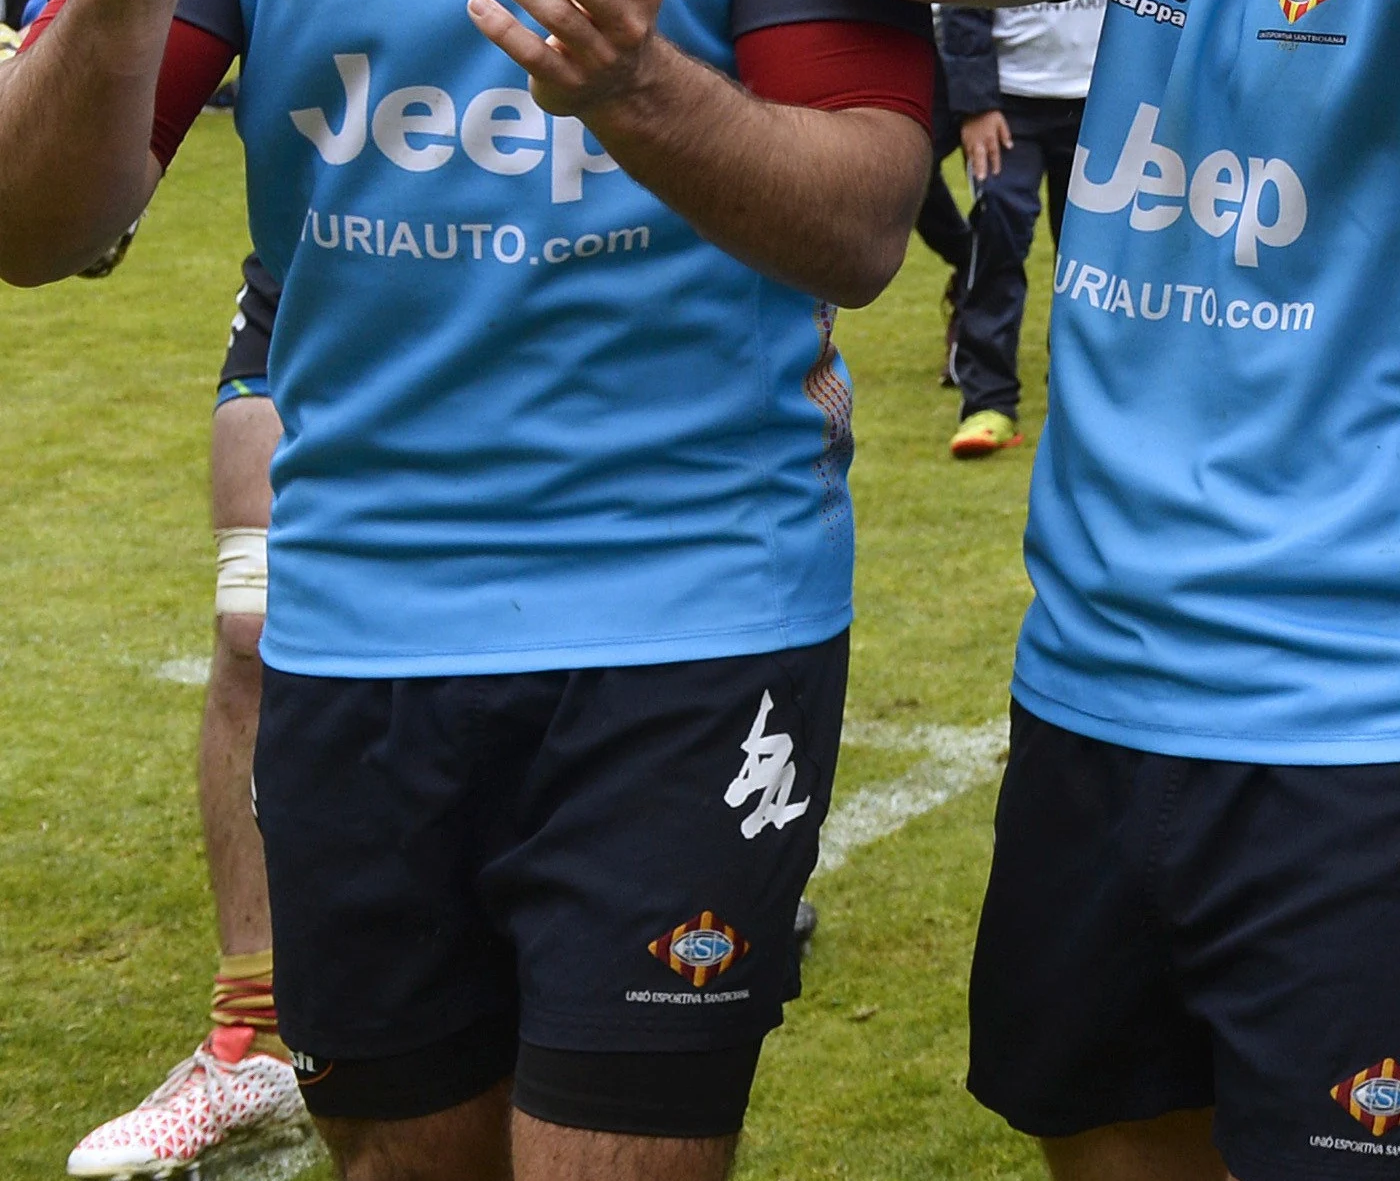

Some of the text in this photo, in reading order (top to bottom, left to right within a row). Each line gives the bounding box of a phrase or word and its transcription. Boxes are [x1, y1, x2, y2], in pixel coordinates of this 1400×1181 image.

[290, 53, 622, 205] Jeep
[1067, 102, 1308, 268] Jeep
[1054, 253, 1315, 331] URIAUTO.com
